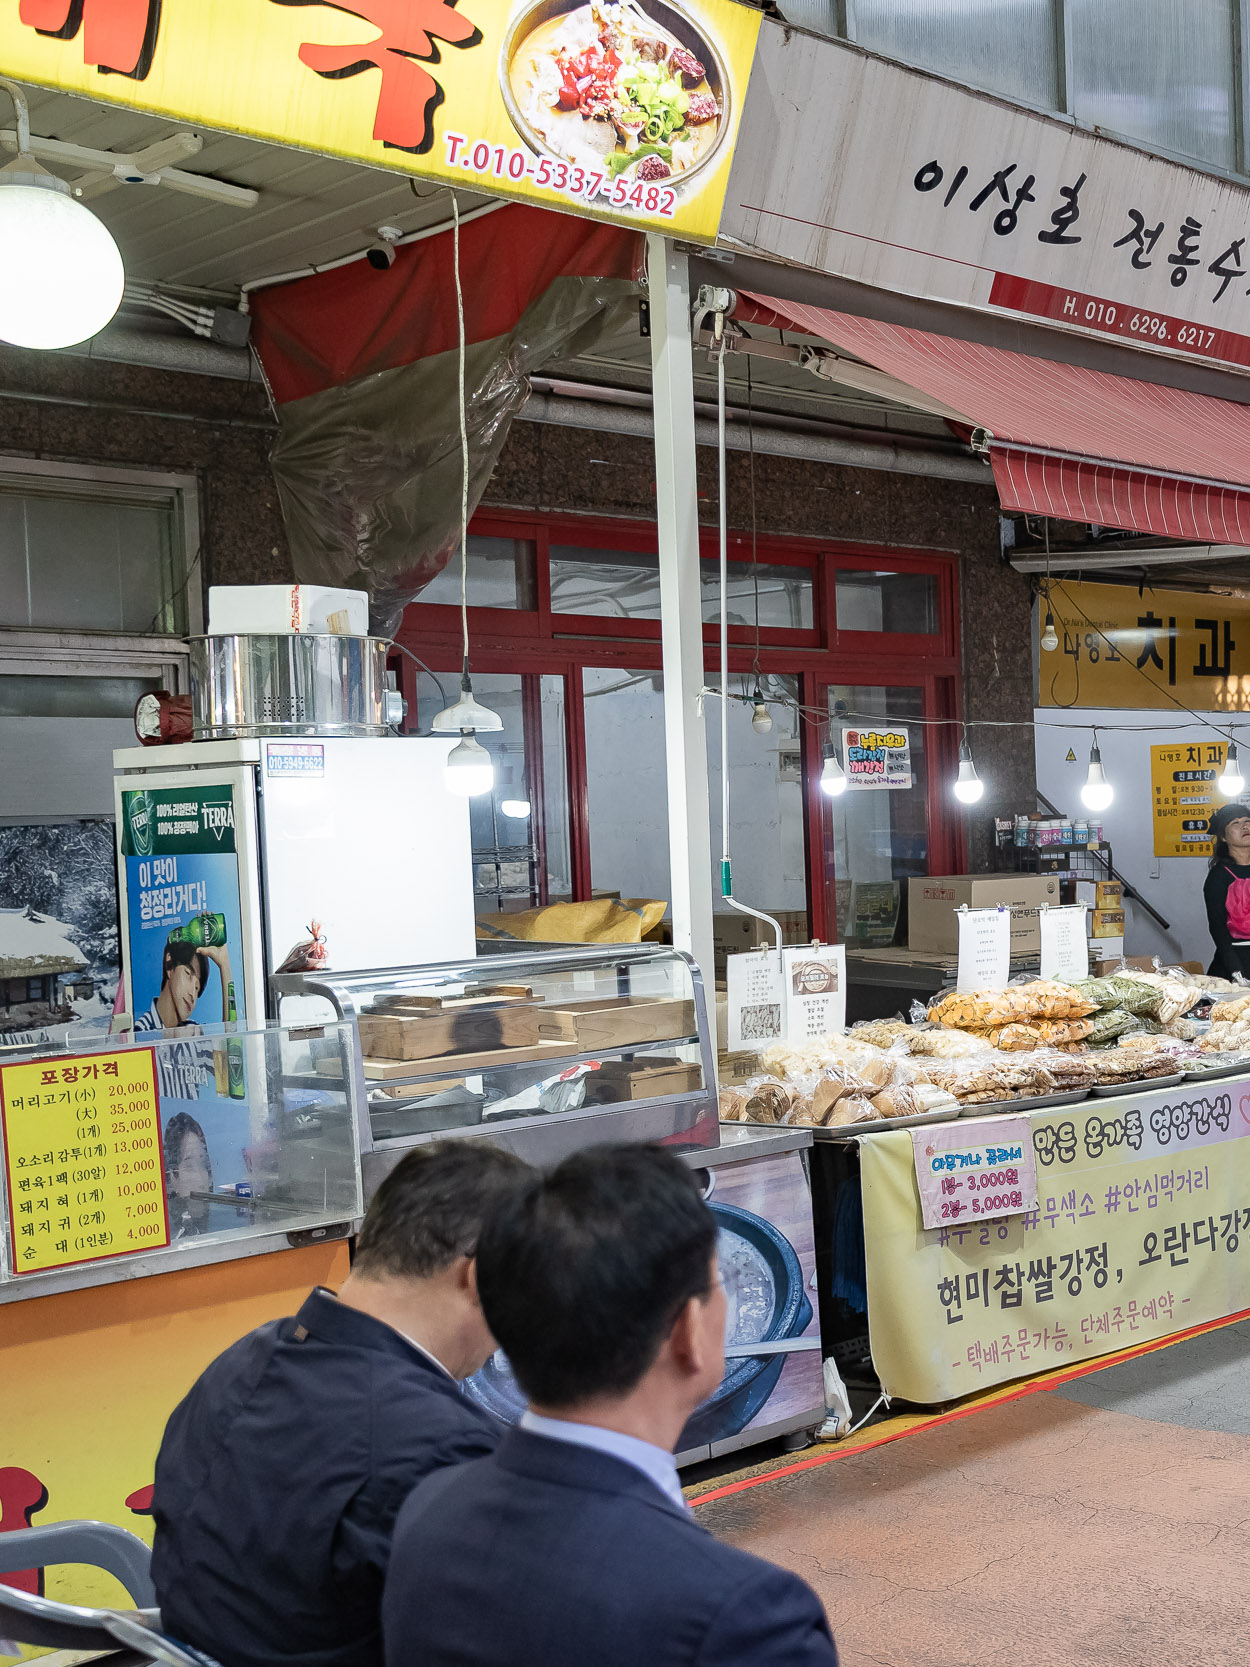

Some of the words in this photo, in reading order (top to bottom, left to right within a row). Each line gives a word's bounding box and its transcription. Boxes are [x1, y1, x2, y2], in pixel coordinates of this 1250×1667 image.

[447, 135, 676, 216] T.010-5337-5482
[913, 159, 1088, 246] 이상호
[1176, 322, 1217, 349] 6217
[1136, 611, 1235, 686] 치과
[269, 756, 323, 769] 010-5949-6622
[1186, 746, 1223, 766] 치과
[157, 804, 172, 817] 100%
[202, 806, 235, 829] TERRA
[158, 822, 173, 835] 100%
[139, 862, 151, 888] 이
[153, 857, 178, 886] 맛이
[140, 880, 207, 920] 청정라거다!
[40, 1061, 119, 1085] 포장가격
[76, 1106, 97, 1121] (大)
[77, 1124, 100, 1140] (1개)
[1033, 1124, 1078, 1168] 만든
[1084, 1110, 1144, 1159] 온가족
[1150, 1093, 1233, 1146] 영양간식
[932, 1153, 982, 1171] 아무거나
[986, 1147, 1022, 1165] 골라서
[967, 1169, 1018, 1191] 3,000원
[77, 1188, 104, 1205] (1개)
[972, 1191, 1022, 1213] 5,000원
[1021, 1192, 1096, 1233] #무색소
[1104, 1165, 1211, 1215] #안심먹거리
[78, 1210, 106, 1227] (2개)
[126, 1202, 158, 1218] 7,000
[75, 1231, 113, 1251] (1인분)
[127, 1223, 160, 1240] 4,000
[937, 1242, 1124, 1325] 현미찹쌀강정,
[966, 1319, 1074, 1374] 택배주문가능,
[1079, 1290, 1175, 1345] 단체주문예약
